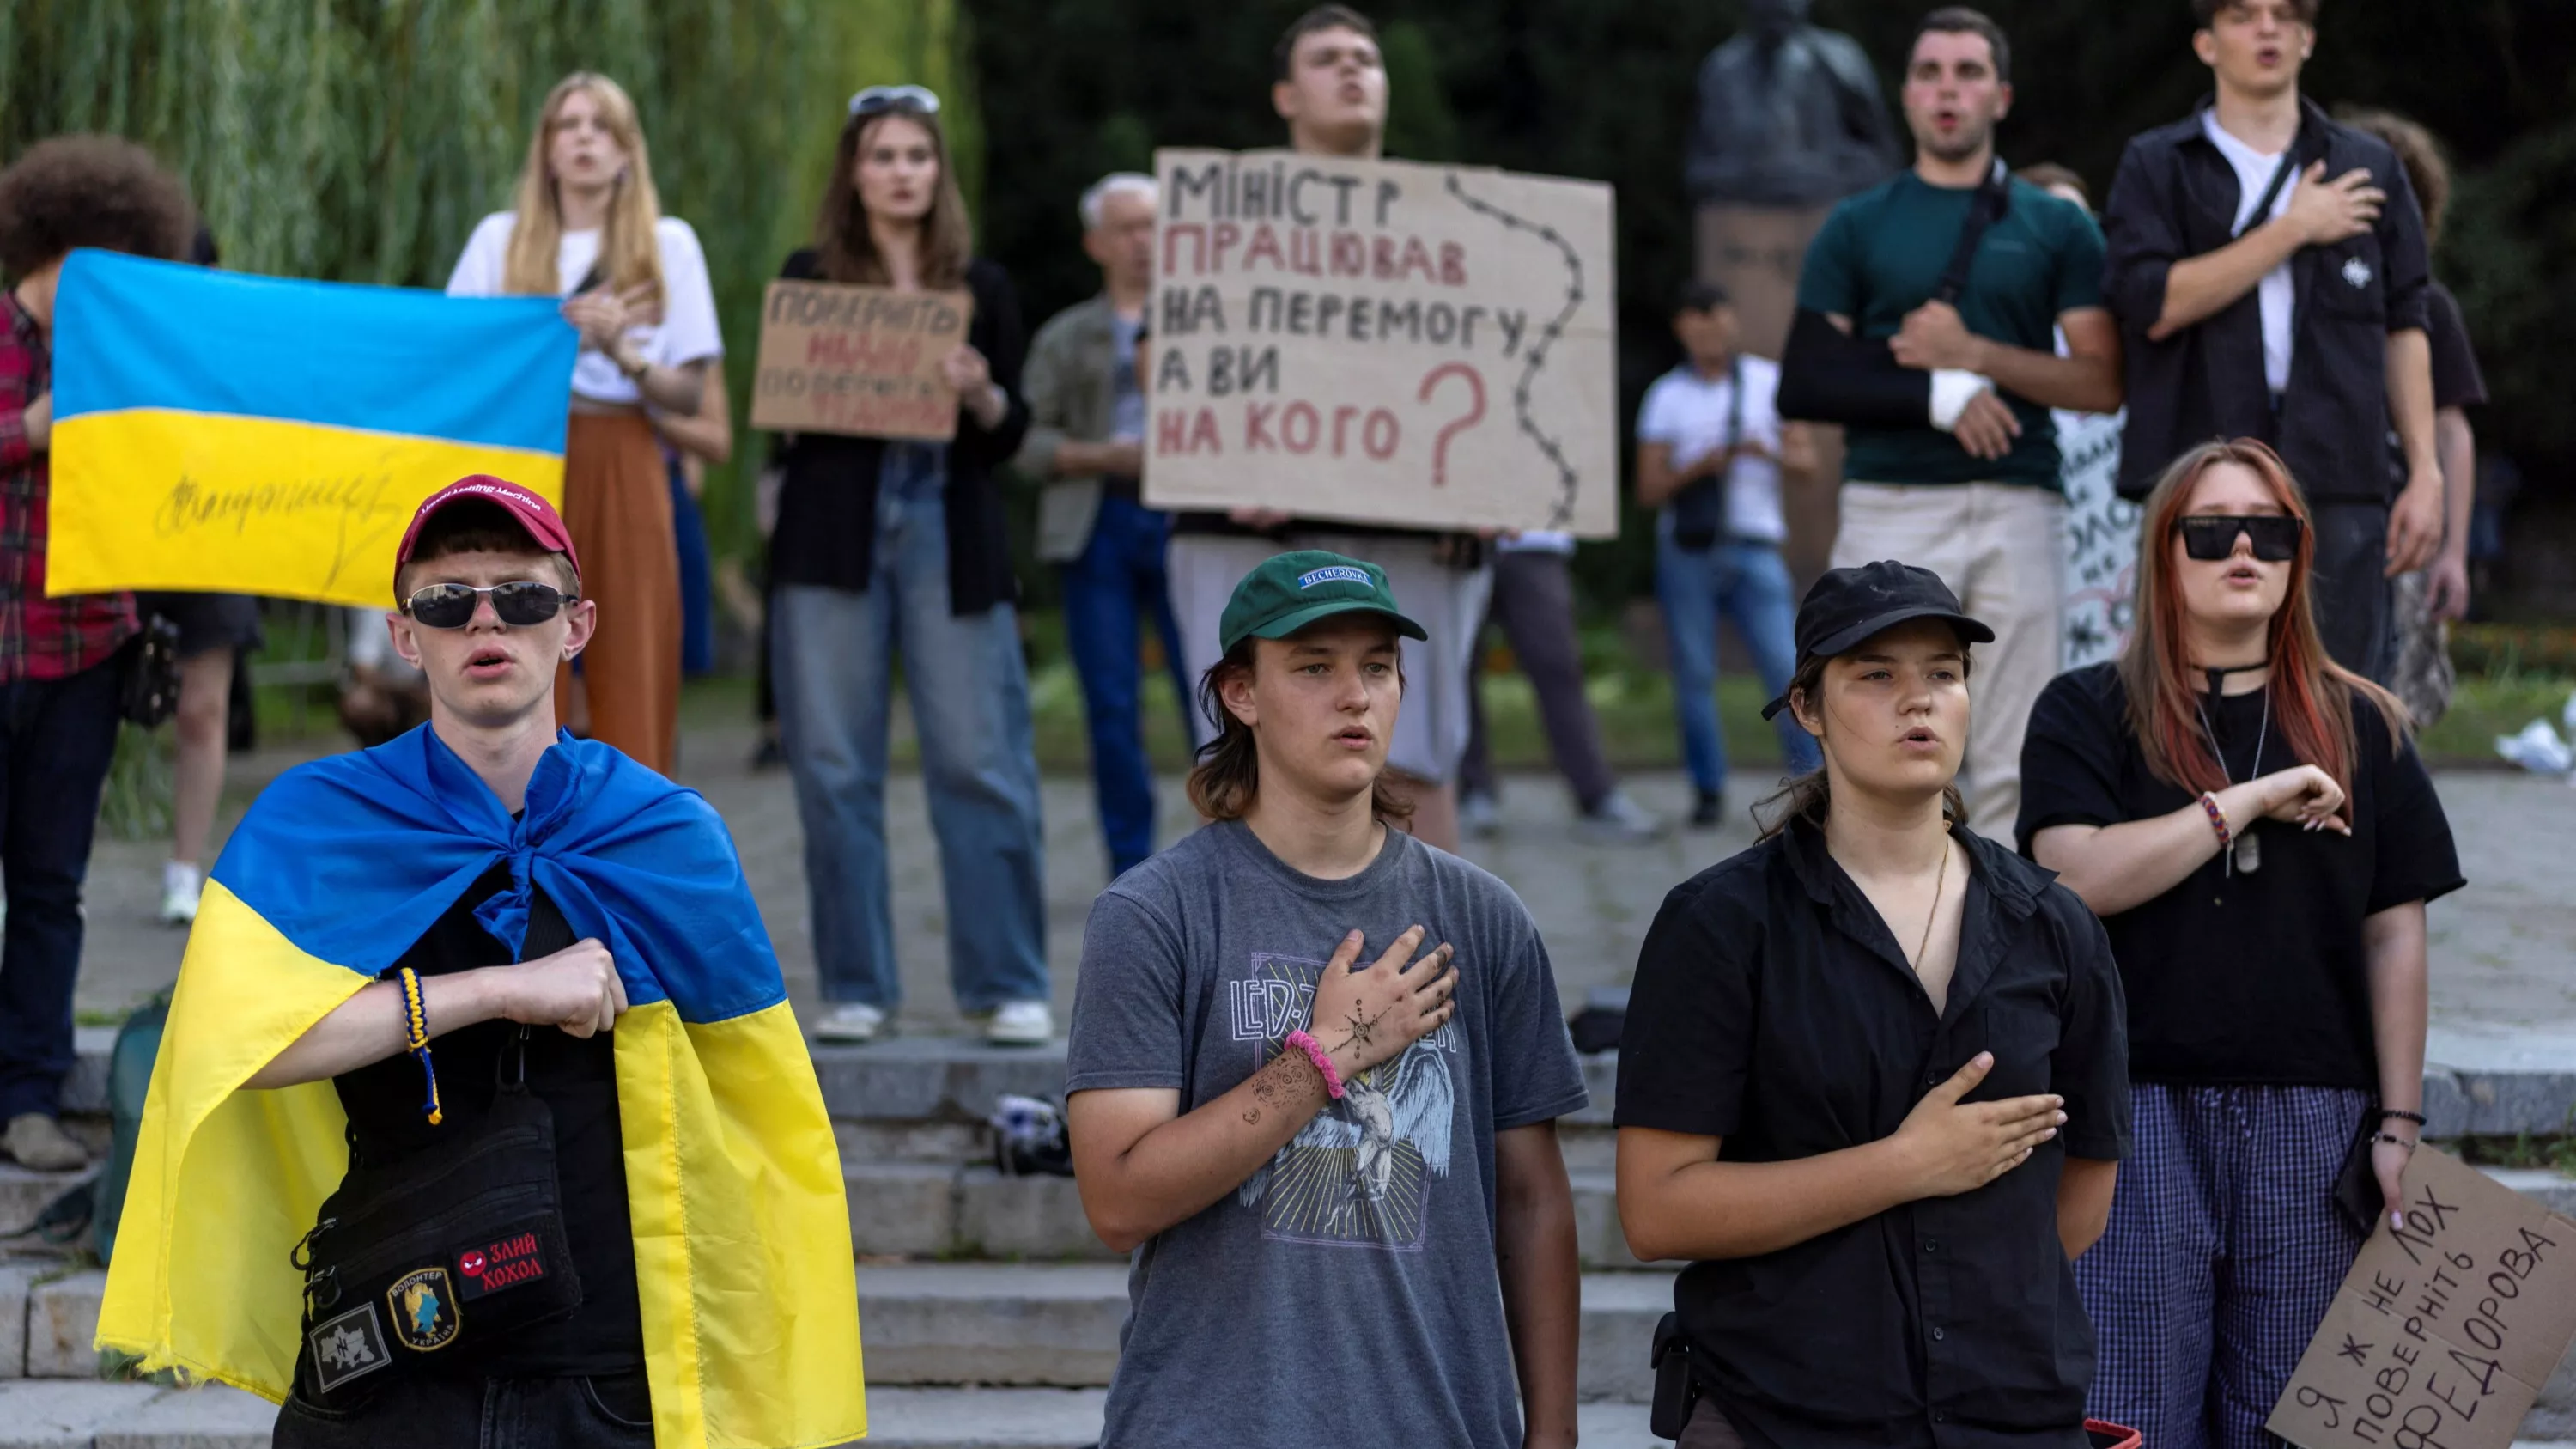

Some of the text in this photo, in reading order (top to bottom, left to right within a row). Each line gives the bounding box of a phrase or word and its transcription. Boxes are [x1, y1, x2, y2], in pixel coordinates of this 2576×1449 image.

[1167, 161, 1403, 227] МІНІСТР
[1162, 221, 1469, 287] ПРАЦЮВАВ
[1160, 284, 1528, 359] НА ПЕРЕМОГУ
[1157, 345, 1281, 398] А ВИ
[1156, 405, 1223, 458] НА
[1243, 399, 1403, 462] КОГО
[497, 486, 541, 510] Machine
[1303, 568, 1370, 585] BECHEROVKA
[481, 1257, 544, 1292] ХОХОЛ
[489, 1232, 538, 1263] ЗЛИЙ
[392, 1271, 443, 1297] ВОЛОНТЕР
[2296, 1184, 2460, 1429] Я Ж НЕ ЛОХ
[411, 1323, 455, 1347] УКРАЇНА
[2353, 1251, 2474, 1445] ПОВЕРНІТЬ
[2393, 1227, 2558, 1449] ФЕДОРОВА
